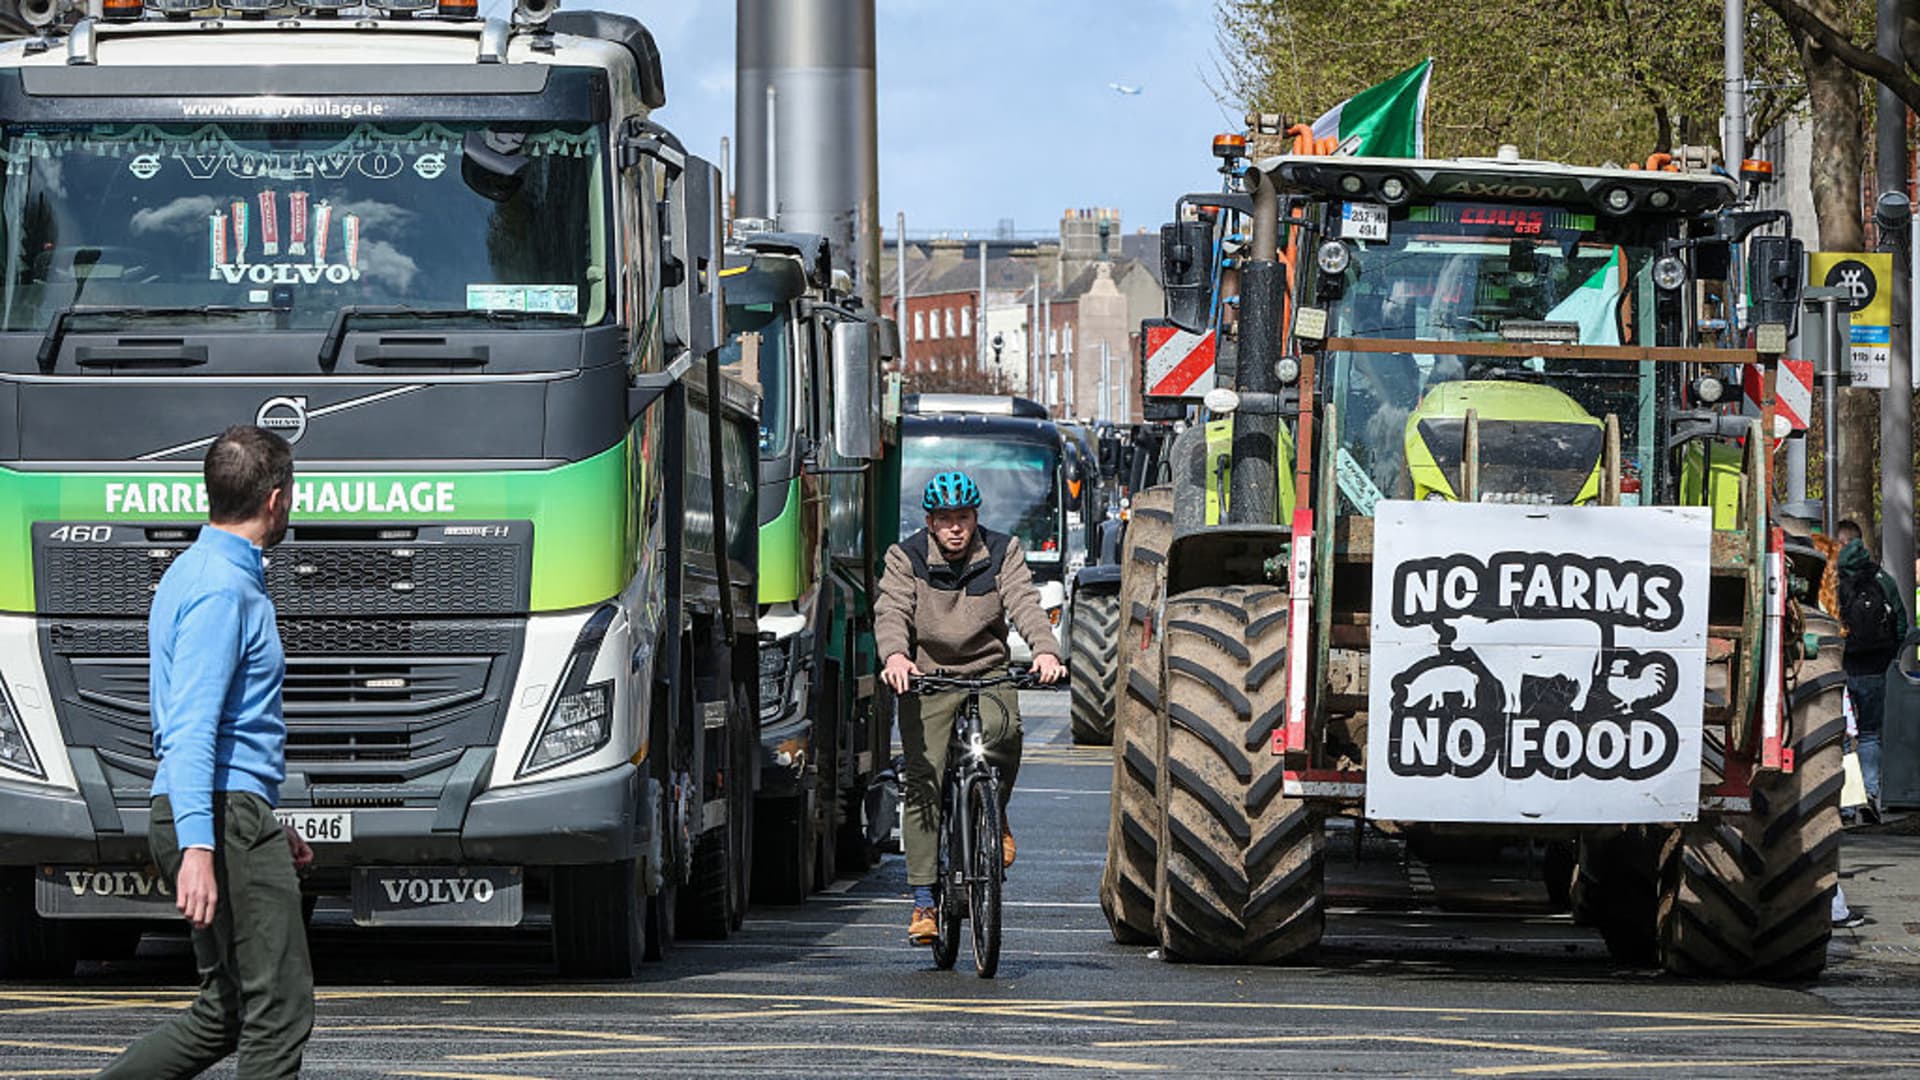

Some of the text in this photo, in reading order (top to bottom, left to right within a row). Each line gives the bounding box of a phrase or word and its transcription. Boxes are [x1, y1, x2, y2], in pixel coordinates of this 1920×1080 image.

[1446, 180, 1567, 199] AXION
[217, 263, 350, 284] VOLVO
[1874, 352, 1886, 363] 44
[105, 481, 455, 513] FARRE HAULAGE
[49, 525, 113, 543] 460
[1404, 563, 1673, 620] NO FARMS
[1400, 717, 1667, 770] NO FOOD
[380, 878, 494, 903] VOLVO
